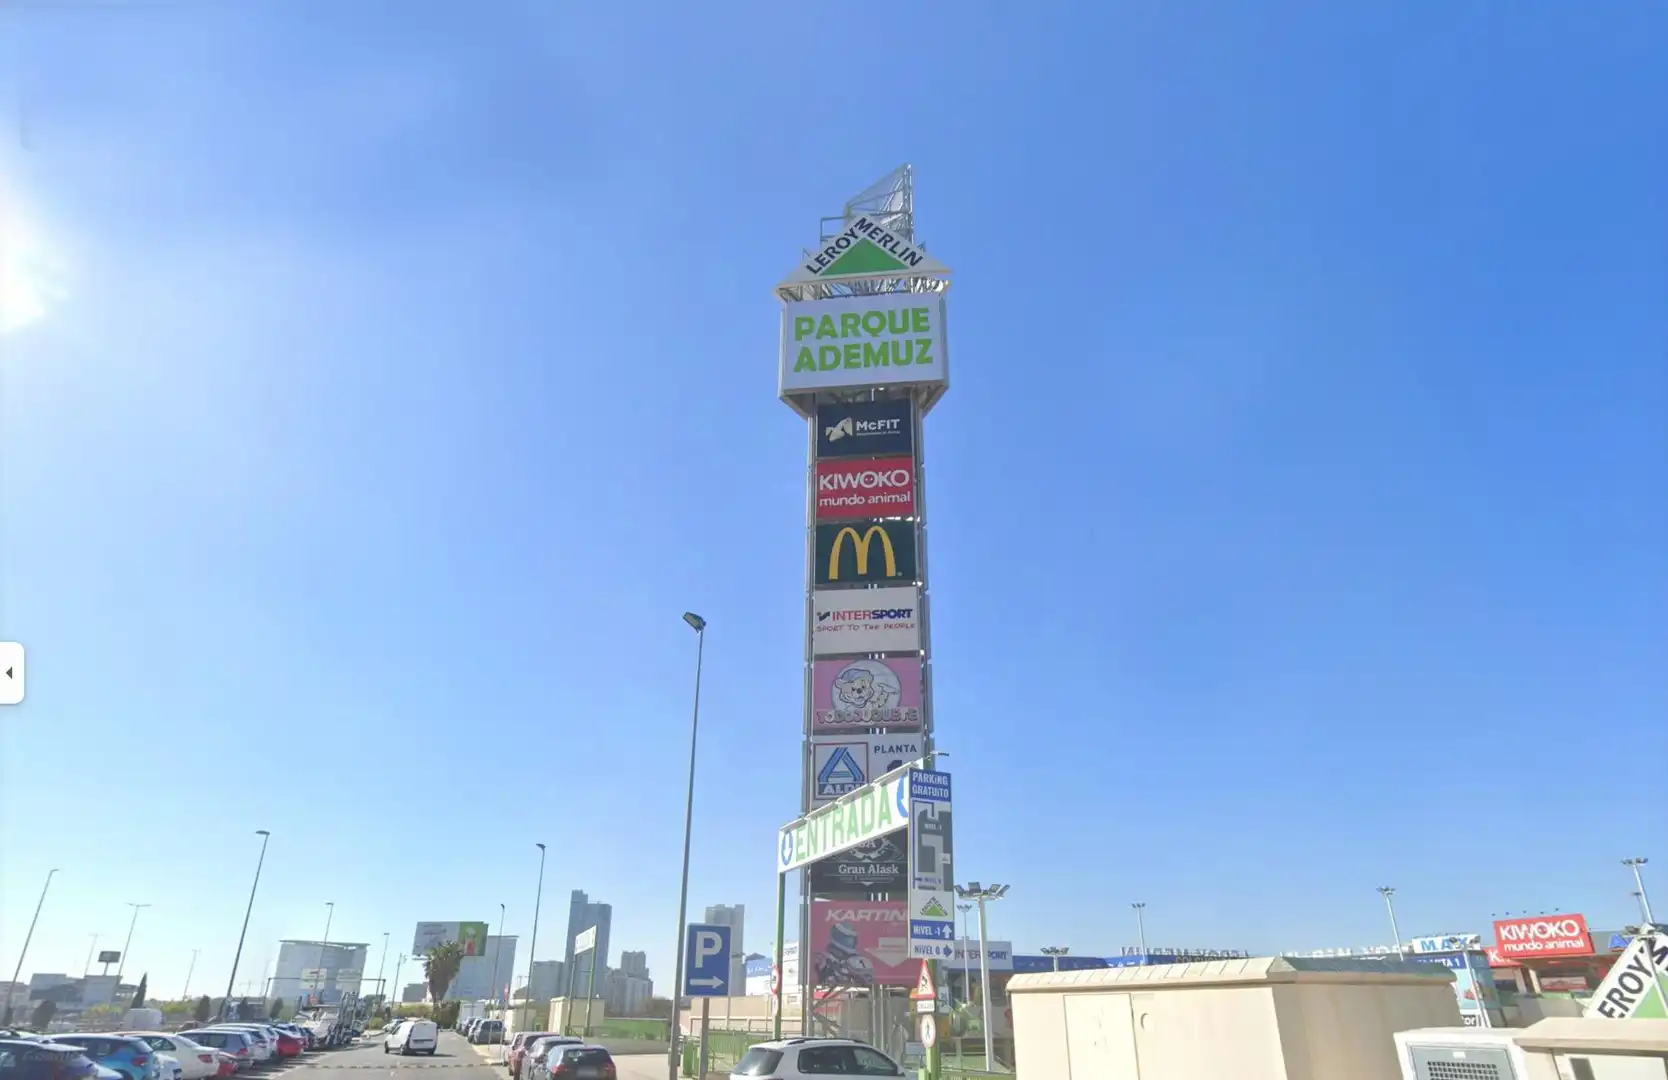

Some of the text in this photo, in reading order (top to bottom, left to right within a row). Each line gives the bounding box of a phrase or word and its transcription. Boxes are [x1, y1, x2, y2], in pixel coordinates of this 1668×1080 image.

[806, 216, 924, 275] LEROY MERLIN
[794, 307, 930, 341] PARQUE
[793, 339, 934, 373] ADEMUZ
[856, 418, 901, 431] McFIT
[819, 469, 910, 490] KIWOKO
[819, 491, 911, 507] mundo animal
[832, 608, 914, 622] INTERSPORT
[847, 623, 860, 631] TO
[883, 622, 915, 630] PEOPLE
[874, 744, 917, 754] PLANTA
[823, 783, 860, 795] ALD
[795, 783, 893, 863] ENTRADA
[838, 863, 900, 874] Gran Alask
[825, 908, 908, 922] KARTIN
[1500, 919, 1580, 941] KIWOKO
[695, 931, 723, 968] P
[1504, 938, 1585, 952] mundo animal
[954, 949, 1008, 961] INTERPORT
[1598, 953, 1653, 1018] EROY
